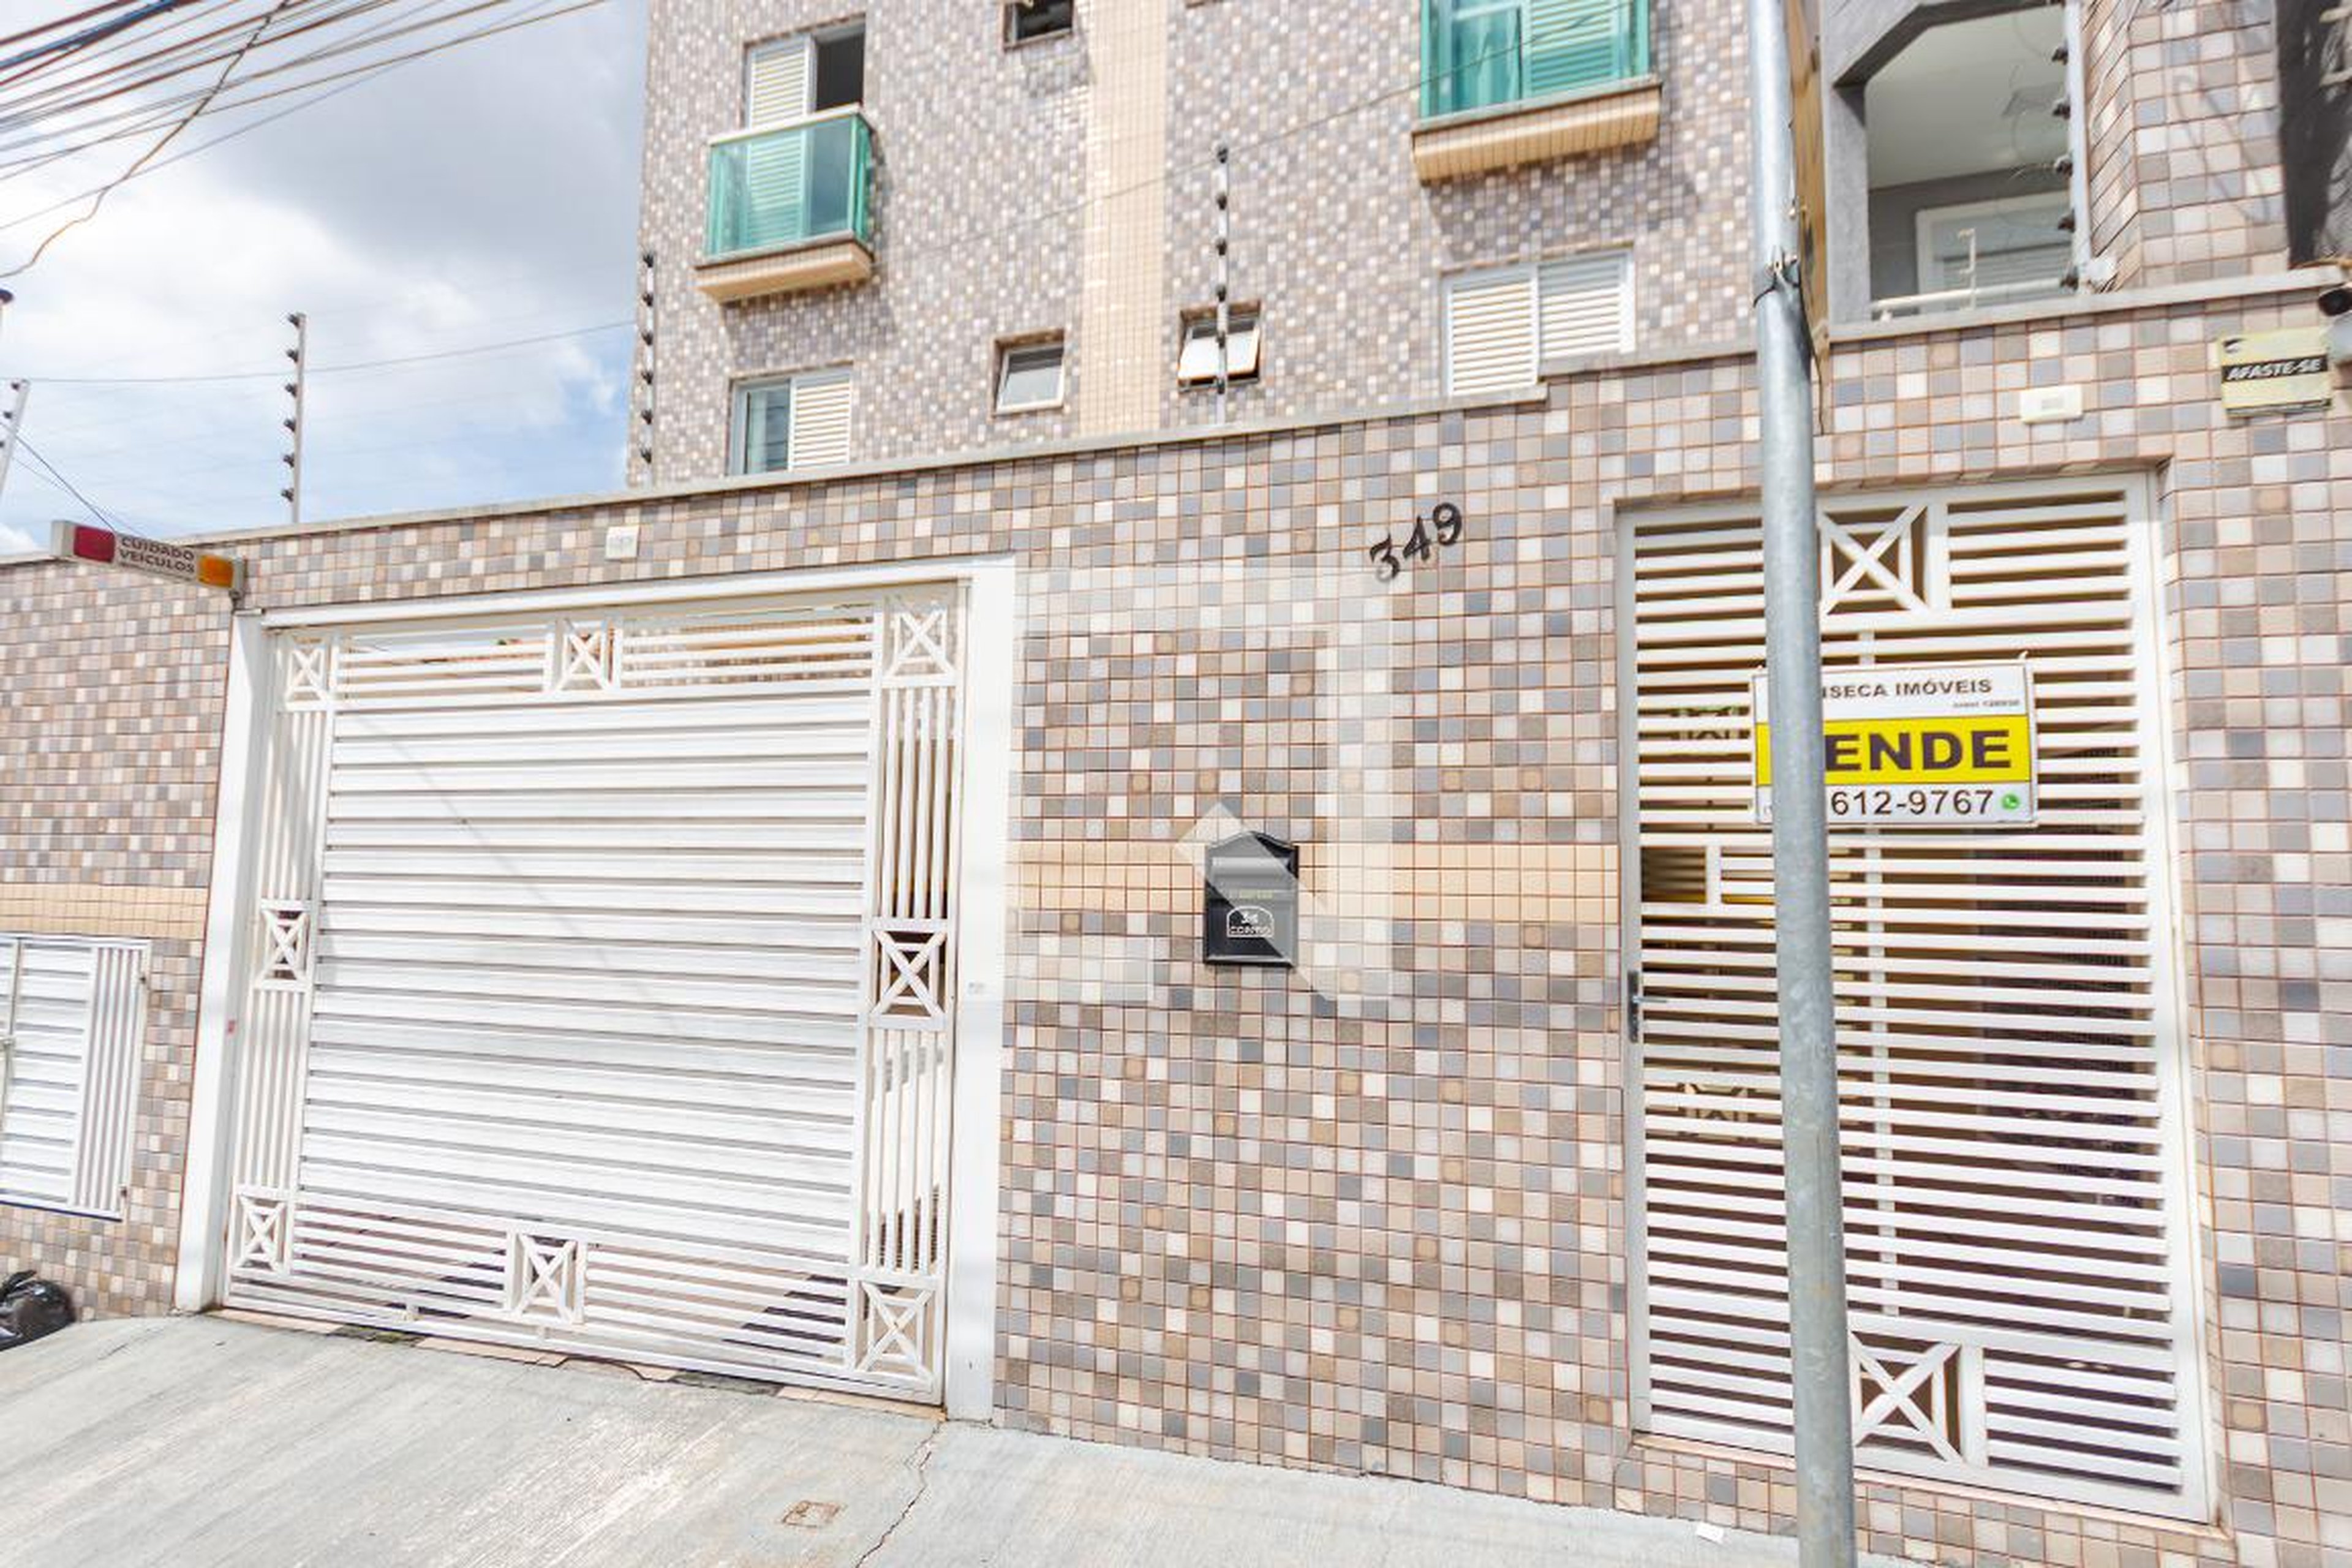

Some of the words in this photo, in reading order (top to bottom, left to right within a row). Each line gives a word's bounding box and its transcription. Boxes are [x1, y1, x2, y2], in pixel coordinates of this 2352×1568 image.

[122, 538, 194, 560] CUIDADO
[1370, 502, 1462, 582] 349
[1822, 684, 1887, 698] SECA
[1896, 679, 1992, 696] IMÓVEIS
[1824, 730, 2011, 771] ENDE
[1831, 790, 1994, 815] 612-9767
